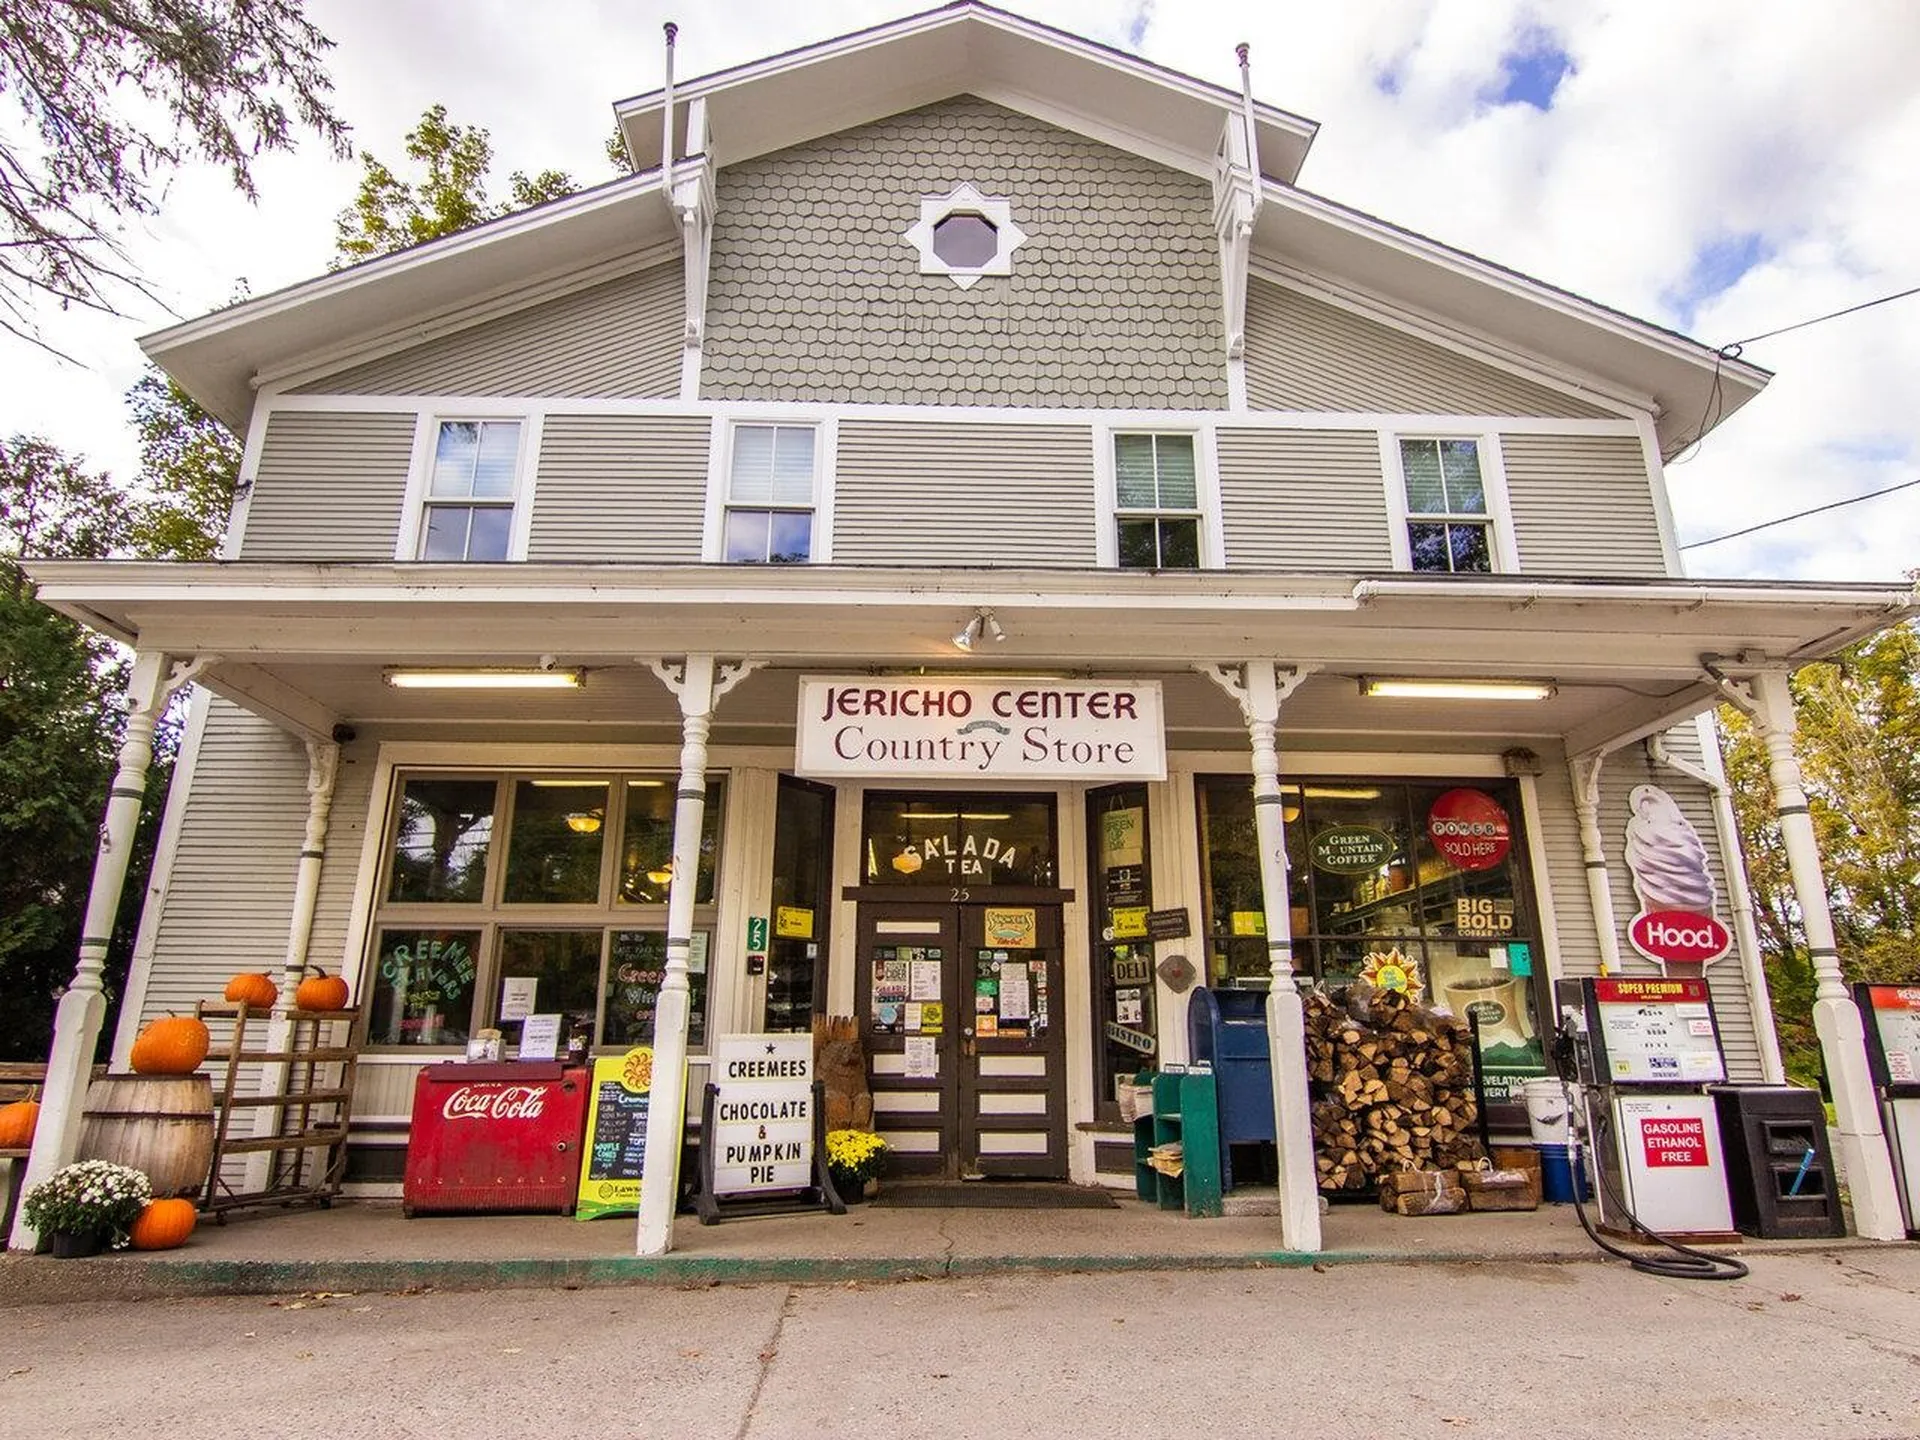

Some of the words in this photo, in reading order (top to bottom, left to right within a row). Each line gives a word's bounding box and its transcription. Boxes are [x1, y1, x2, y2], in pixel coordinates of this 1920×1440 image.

[822, 687, 972, 721] JERICHO
[992, 691, 1138, 720] CENTER
[834, 725, 1001, 769] Country
[1023, 727, 1134, 764] Store
[1329, 834, 1371, 845] GREEN
[1317, 843, 1384, 856] MUNTAIN
[1444, 842, 1471, 857] SOLD
[1472, 842, 1497, 856] HERE
[945, 859, 983, 874] TEA
[1326, 853, 1377, 865] COFFEE
[950, 887, 971, 902] 25
[1457, 898, 1494, 914] BIG
[1457, 914, 1513, 930] BOLD
[752, 918, 762, 950] 25
[1116, 960, 1147, 980] DELI
[1617, 983, 1645, 994] SUPER
[1645, 983, 1684, 994] PREMIUM
[1107, 1023, 1152, 1050] BISTRO
[728, 1060, 807, 1078] CREEMEES
[1483, 1087, 1508, 1098] VERY
[442, 1085, 548, 1120] Coca-Cola
[720, 1101, 807, 1120] CHOCOLATE
[758, 1125, 767, 1140] &
[1643, 1122, 1702, 1135] GASOLINE
[1647, 1136, 1702, 1149] ETHANOL
[726, 1142, 802, 1163] PUMPKIN
[1661, 1151, 1693, 1162] FREE
[750, 1165, 775, 1184] PIE
